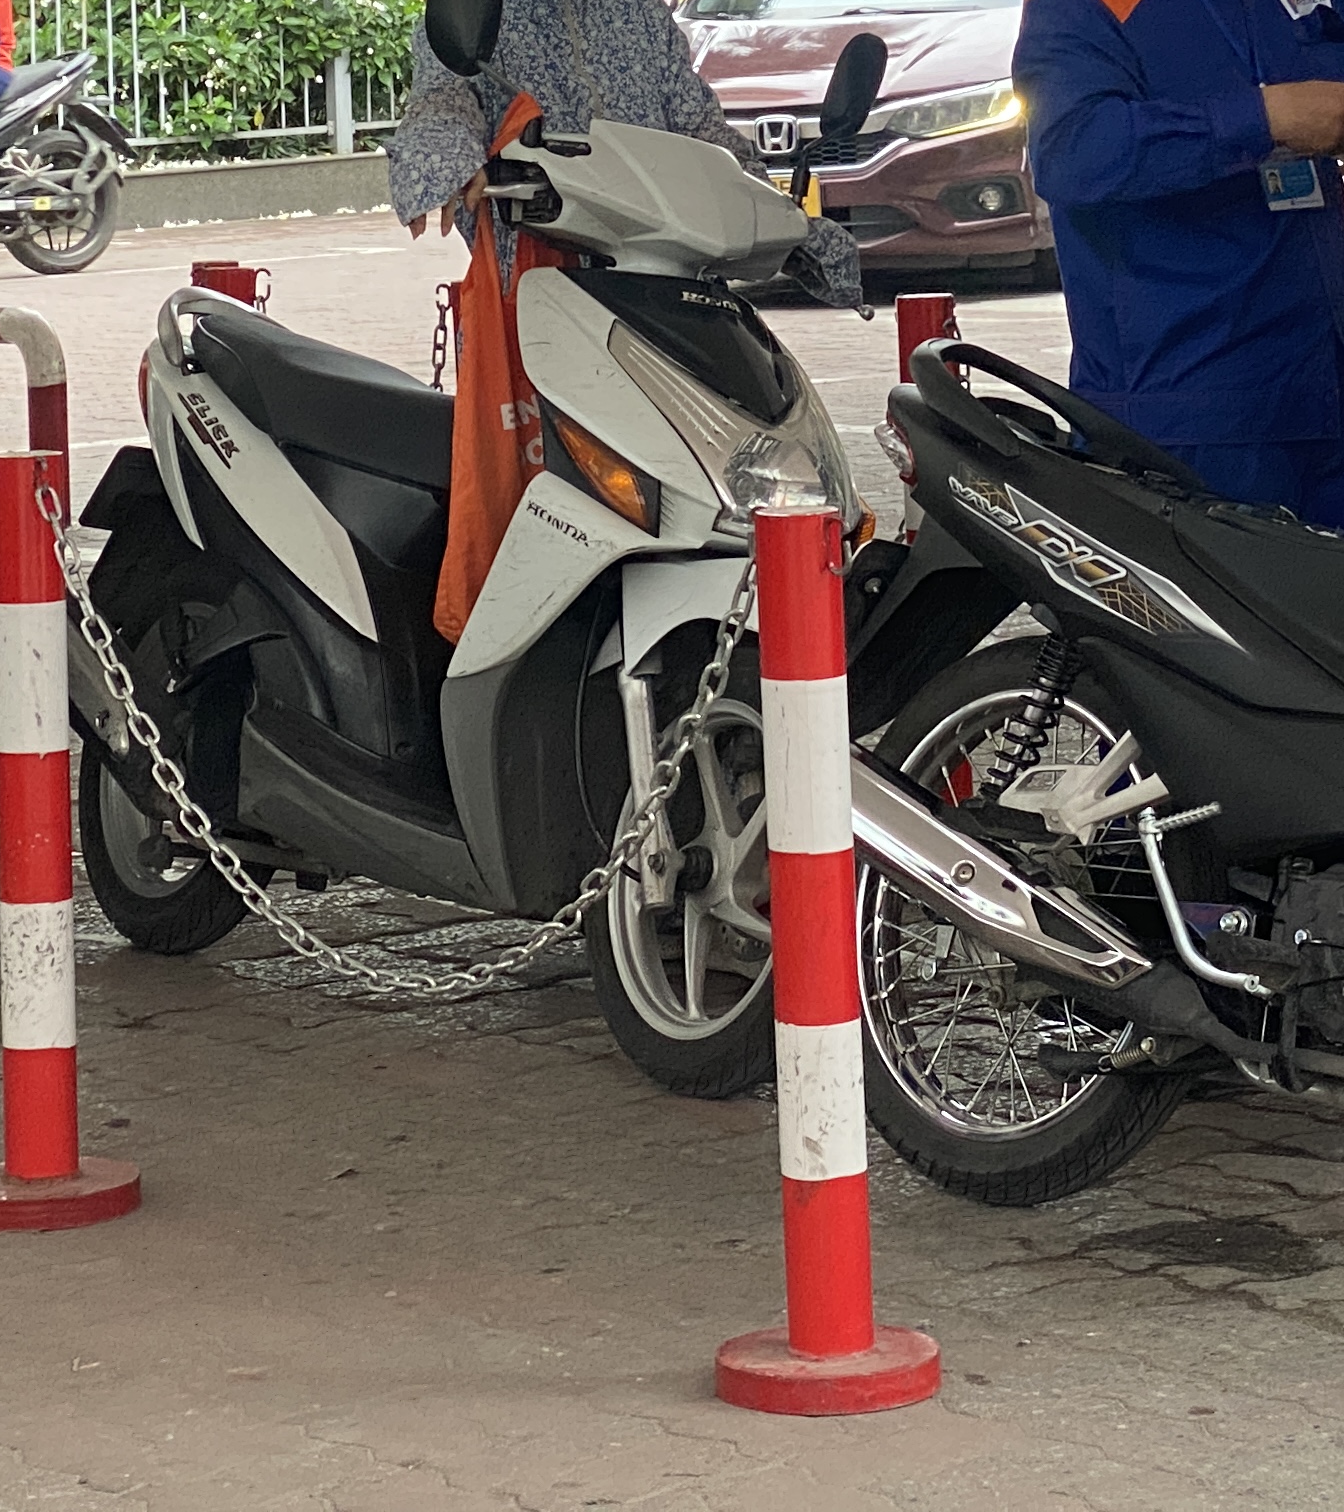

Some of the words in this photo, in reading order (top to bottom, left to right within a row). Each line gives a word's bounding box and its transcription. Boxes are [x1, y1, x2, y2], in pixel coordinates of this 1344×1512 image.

[681, 290, 740, 314] HONDA
[187, 393, 240, 459] CLICK
[526, 500, 589, 547] HONDA
[948, 476, 1019, 526] WAVE
